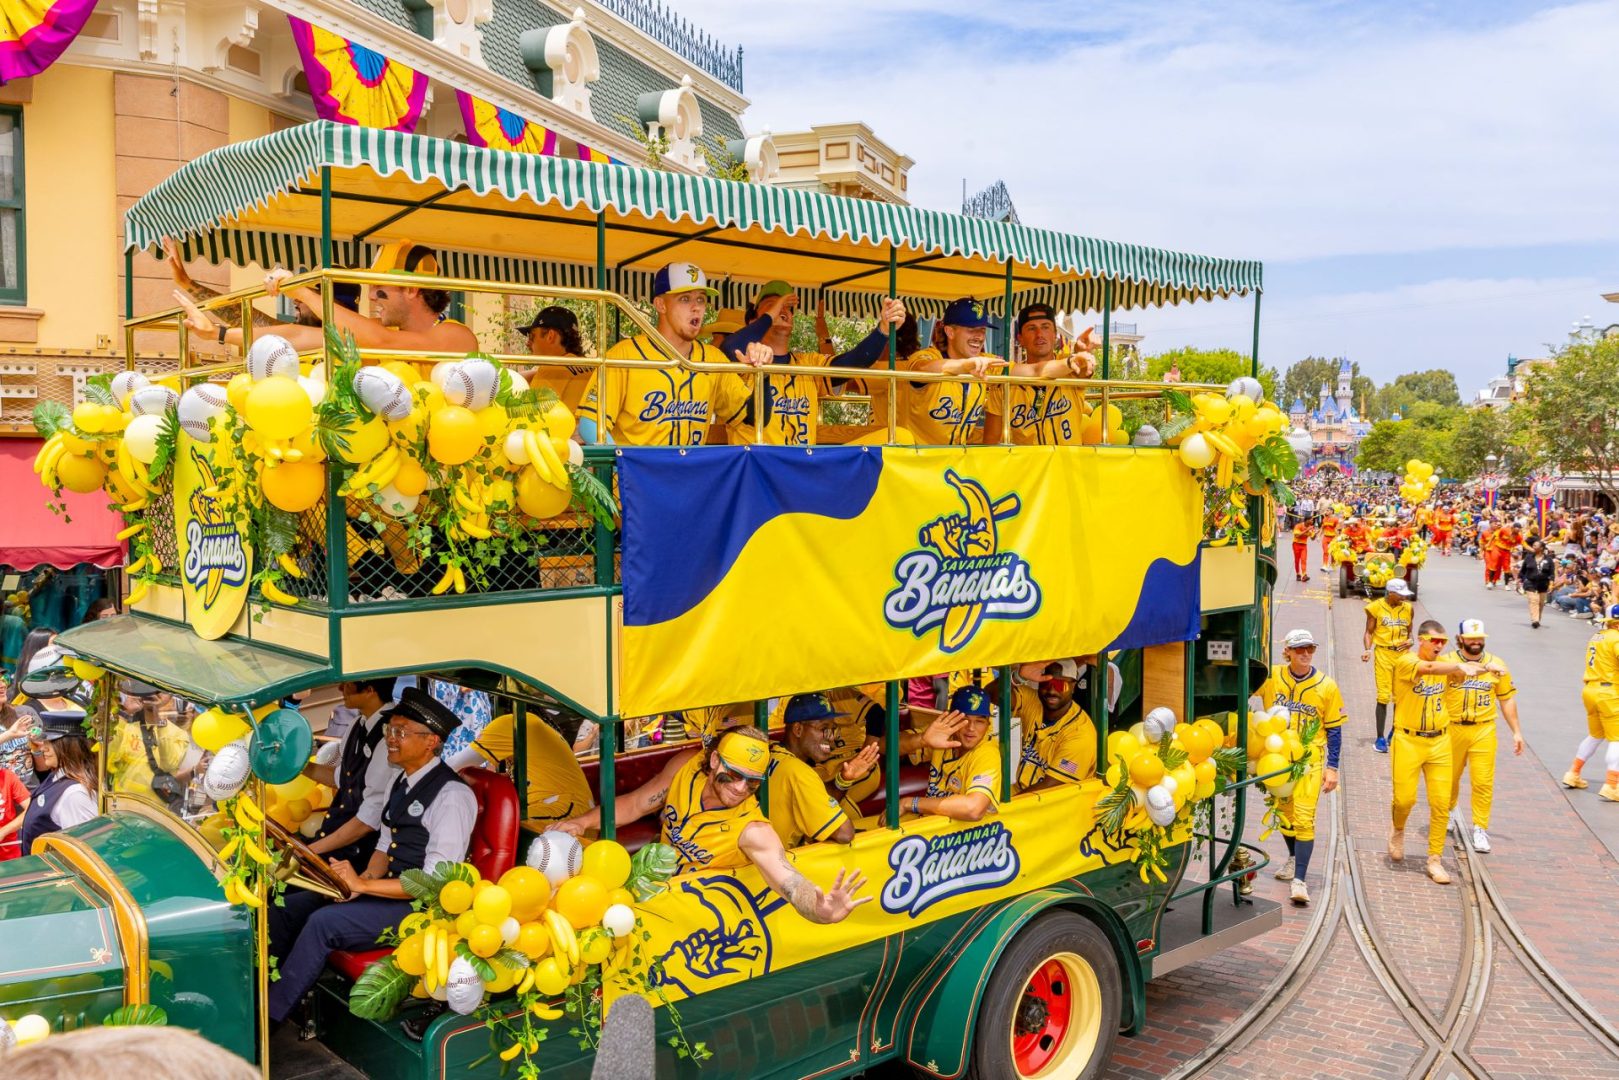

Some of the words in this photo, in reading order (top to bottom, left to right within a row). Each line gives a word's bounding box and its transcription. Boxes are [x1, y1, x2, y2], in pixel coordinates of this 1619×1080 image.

[639, 390, 708, 424] Banana
[1061, 419, 1072, 440] 8
[202, 525, 235, 537] SAVANNAH
[185, 521, 244, 584] Bananas
[941, 555, 1012, 571] SAVANNAH
[885, 554, 1037, 629] Bananas
[930, 824, 999, 853] SAVANNAH
[883, 833, 1017, 913] Bananas
